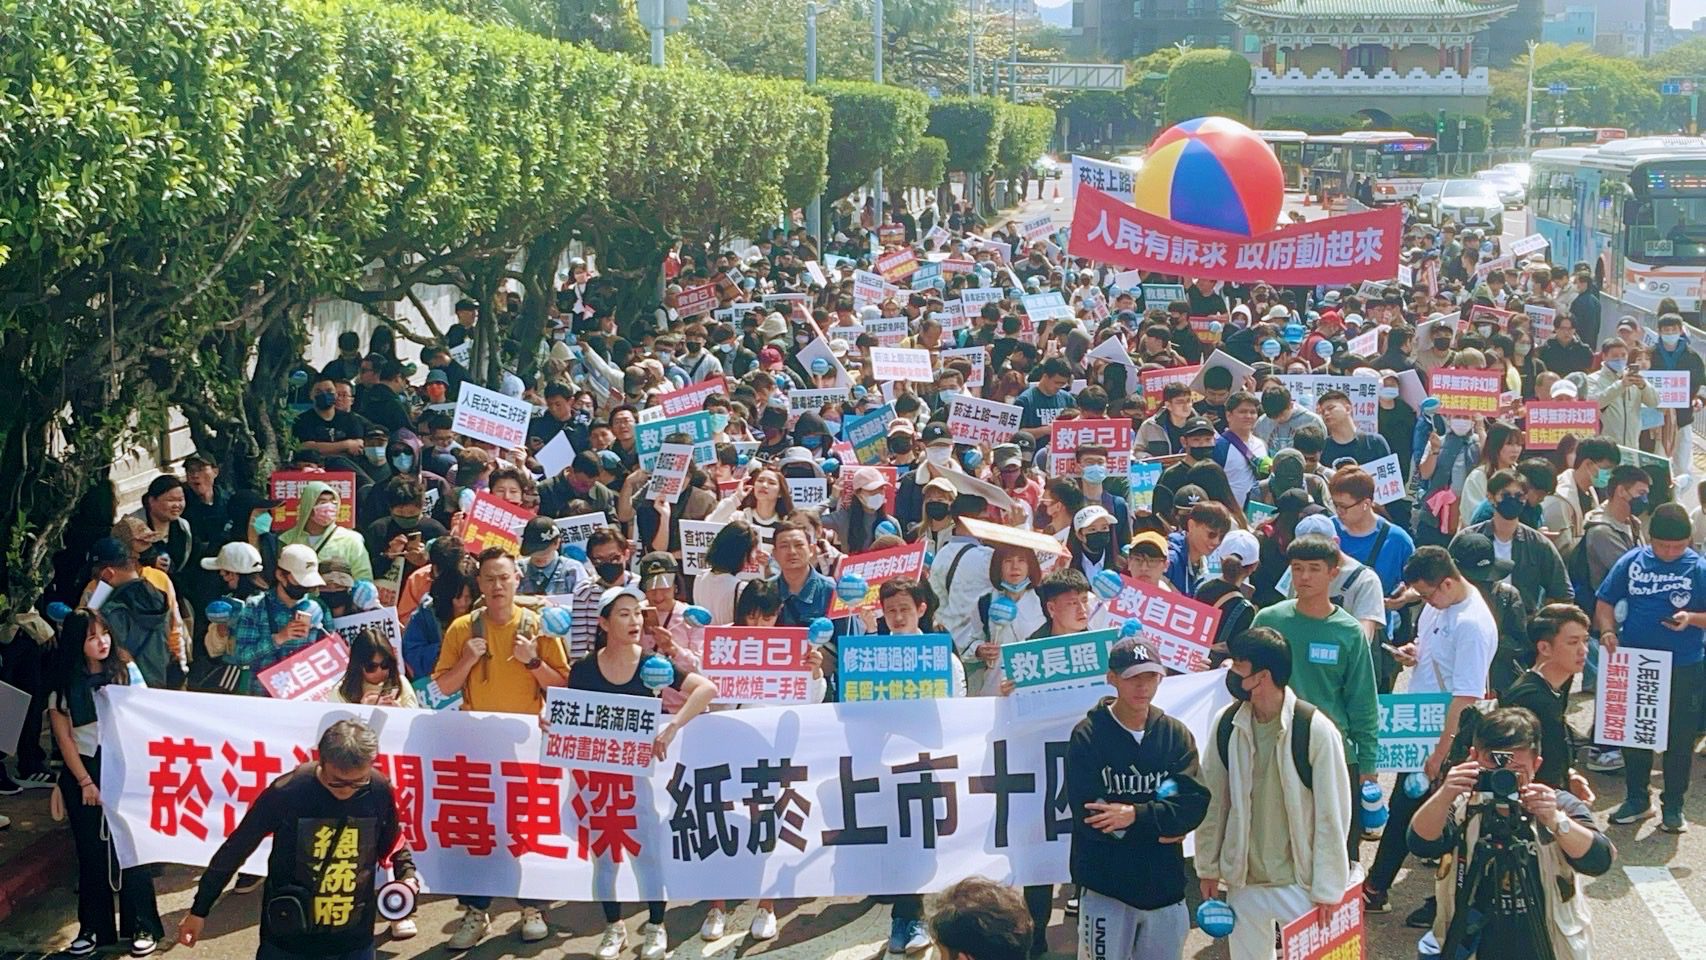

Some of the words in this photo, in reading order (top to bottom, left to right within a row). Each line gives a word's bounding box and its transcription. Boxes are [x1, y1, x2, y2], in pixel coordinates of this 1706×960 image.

[1079, 166, 1137, 193] 菸法上路
[1087, 209, 1228, 268] 人民有訴求
[1234, 226, 1385, 271] 政府動起來
[1432, 373, 1499, 393] 世界無菸非幻想
[461, 390, 528, 425] 人民投出三好球
[953, 402, 1019, 428] 菸法上路一周年
[1529, 408, 1597, 425] 世界無菸非幻想
[1056, 427, 1128, 450] 救自己！
[790, 486, 824, 503] 三好球
[473, 499, 530, 534] 若要世界無
[1116, 585, 1214, 642] 救自己！
[709, 637, 808, 666] 救自己！
[843, 645, 949, 673] 修法通過卻卡關
[270, 641, 350, 699] 救自己！
[550, 699, 656, 735] 菸法上路滿周年
[1633, 654, 1661, 745] 人民投出三好球
[546, 733, 654, 768] 政府畫餅全發霉
[148, 736, 638, 864] 菸法關毒更深
[312, 824, 360, 927] 總統府
